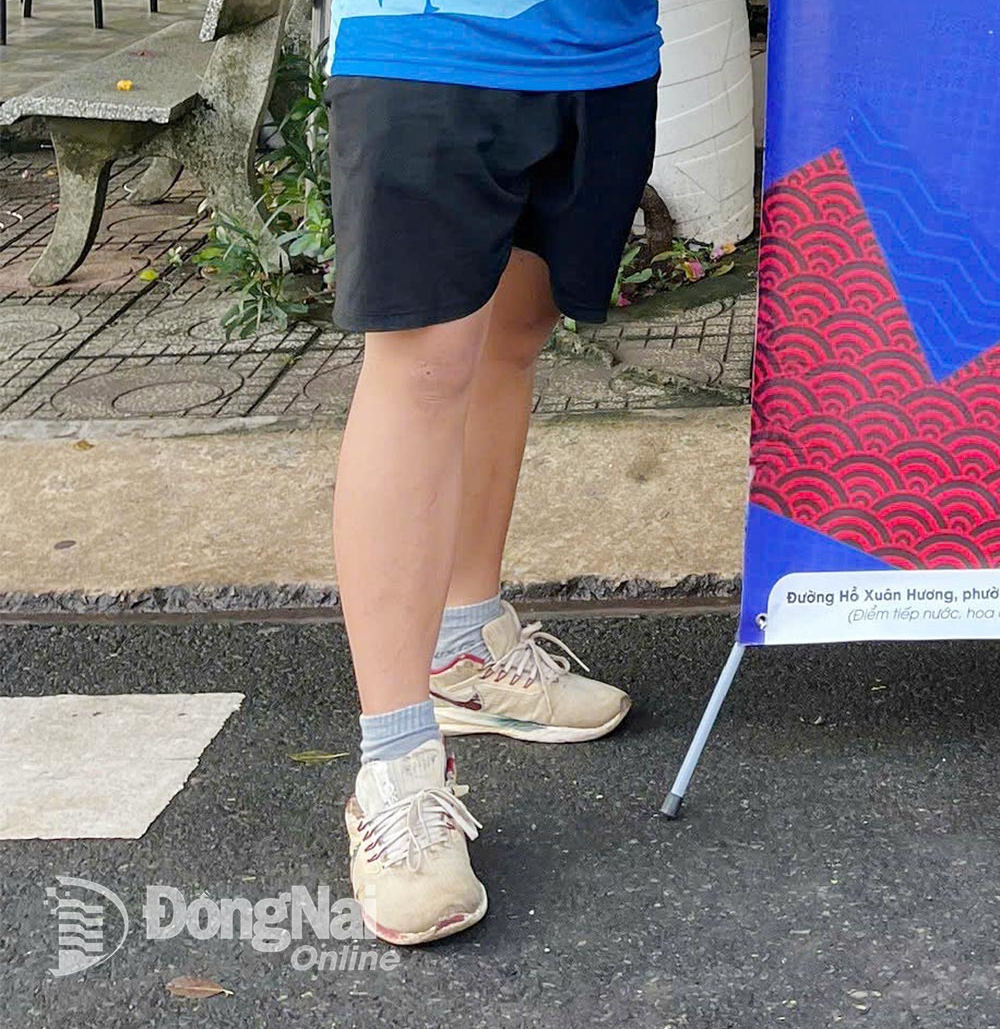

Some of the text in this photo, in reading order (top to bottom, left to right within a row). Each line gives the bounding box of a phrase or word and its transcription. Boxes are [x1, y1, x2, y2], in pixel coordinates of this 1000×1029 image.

[786, 589, 835, 606] Đường
[864, 588, 901, 602] Xuân
[906, 588, 958, 604] Hương,
[847, 605, 889, 624] (Điểm
[893, 605, 920, 622] tiếp
[966, 606, 995, 619] hoa
